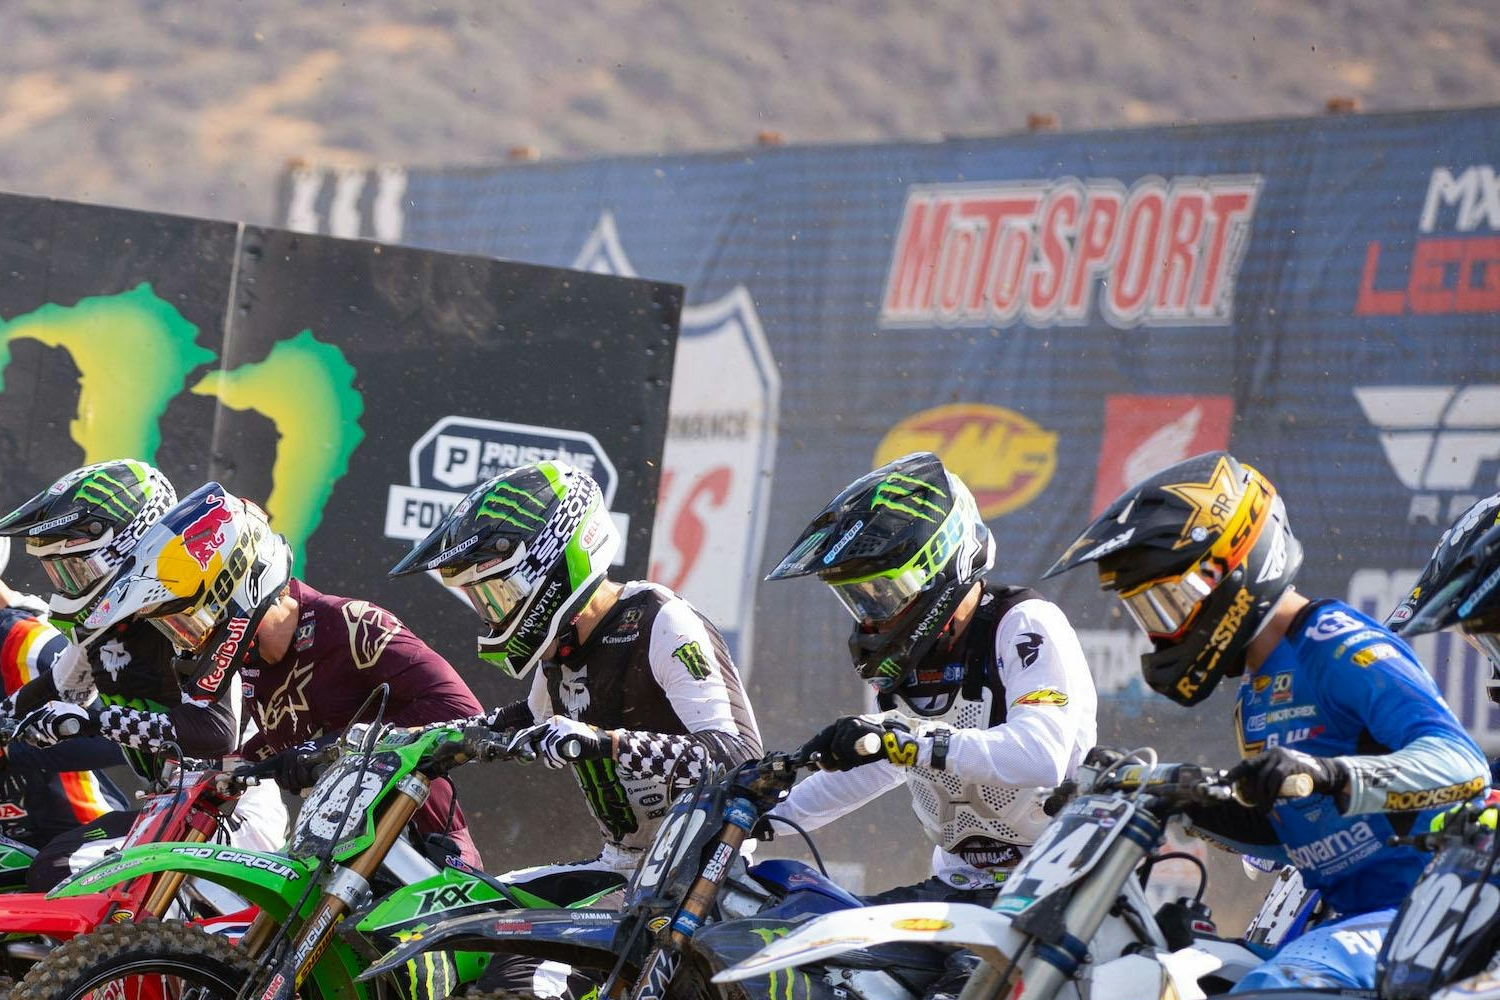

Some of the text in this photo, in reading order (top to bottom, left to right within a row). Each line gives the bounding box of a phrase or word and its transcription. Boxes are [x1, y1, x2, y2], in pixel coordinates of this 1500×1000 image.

[481, 441, 596, 475] PRISTINE
[116, 492, 174, 556] SCOT
[516, 580, 563, 639] MONSTER
[910, 586, 955, 642] MONSTER
[1270, 705, 1317, 722] MOTOREX
[1384, 777, 1487, 811] ROCKSTAR
[216, 850, 302, 882] CIRCUIT
[416, 883, 479, 918] KX
[579, 912, 612, 921] YAMAHA
[1331, 929, 1383, 956] FLY
